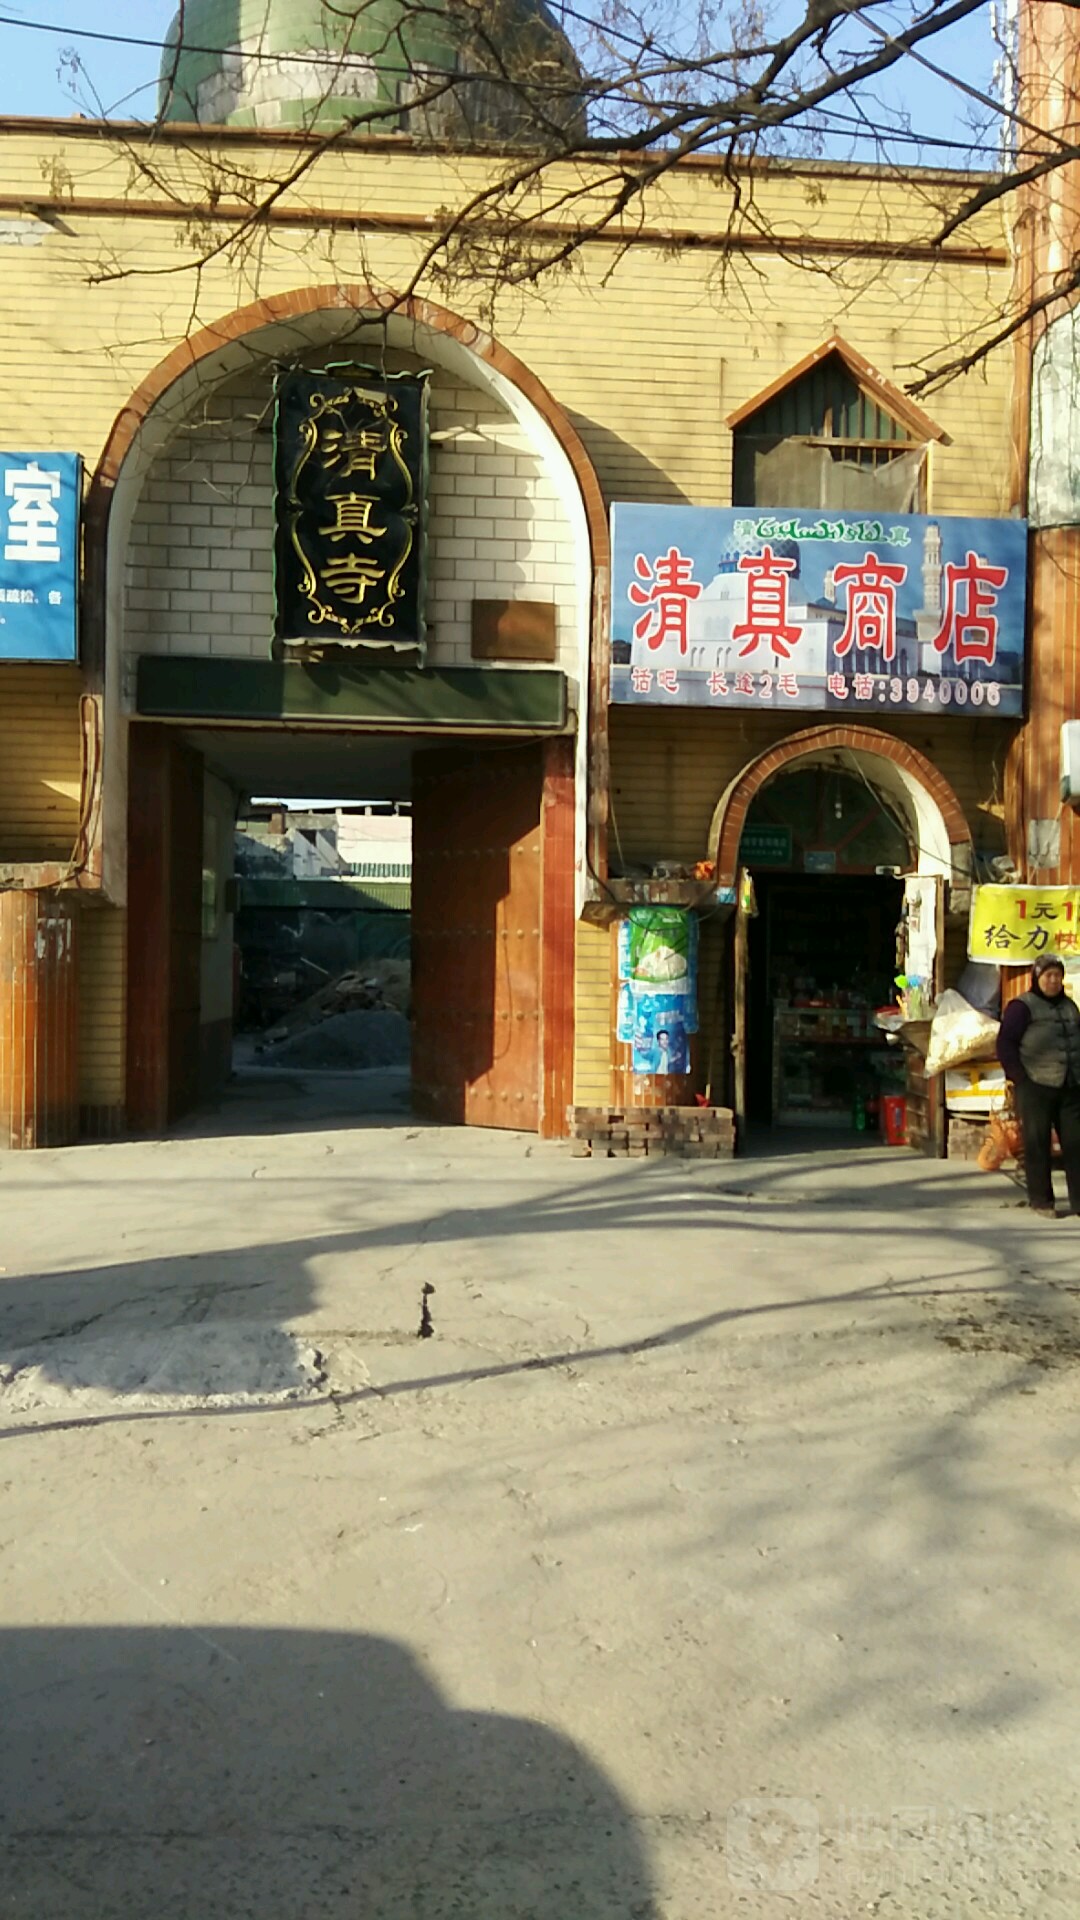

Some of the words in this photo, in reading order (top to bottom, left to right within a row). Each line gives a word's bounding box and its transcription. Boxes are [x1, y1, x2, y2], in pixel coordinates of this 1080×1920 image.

[4, 461, 60, 562] 室
[317, 428, 388, 604] 清真寺
[628, 545, 1008, 666] 清真商店
[631, 668, 679, 694] 话吧
[707, 671, 799, 698] 长途2毛
